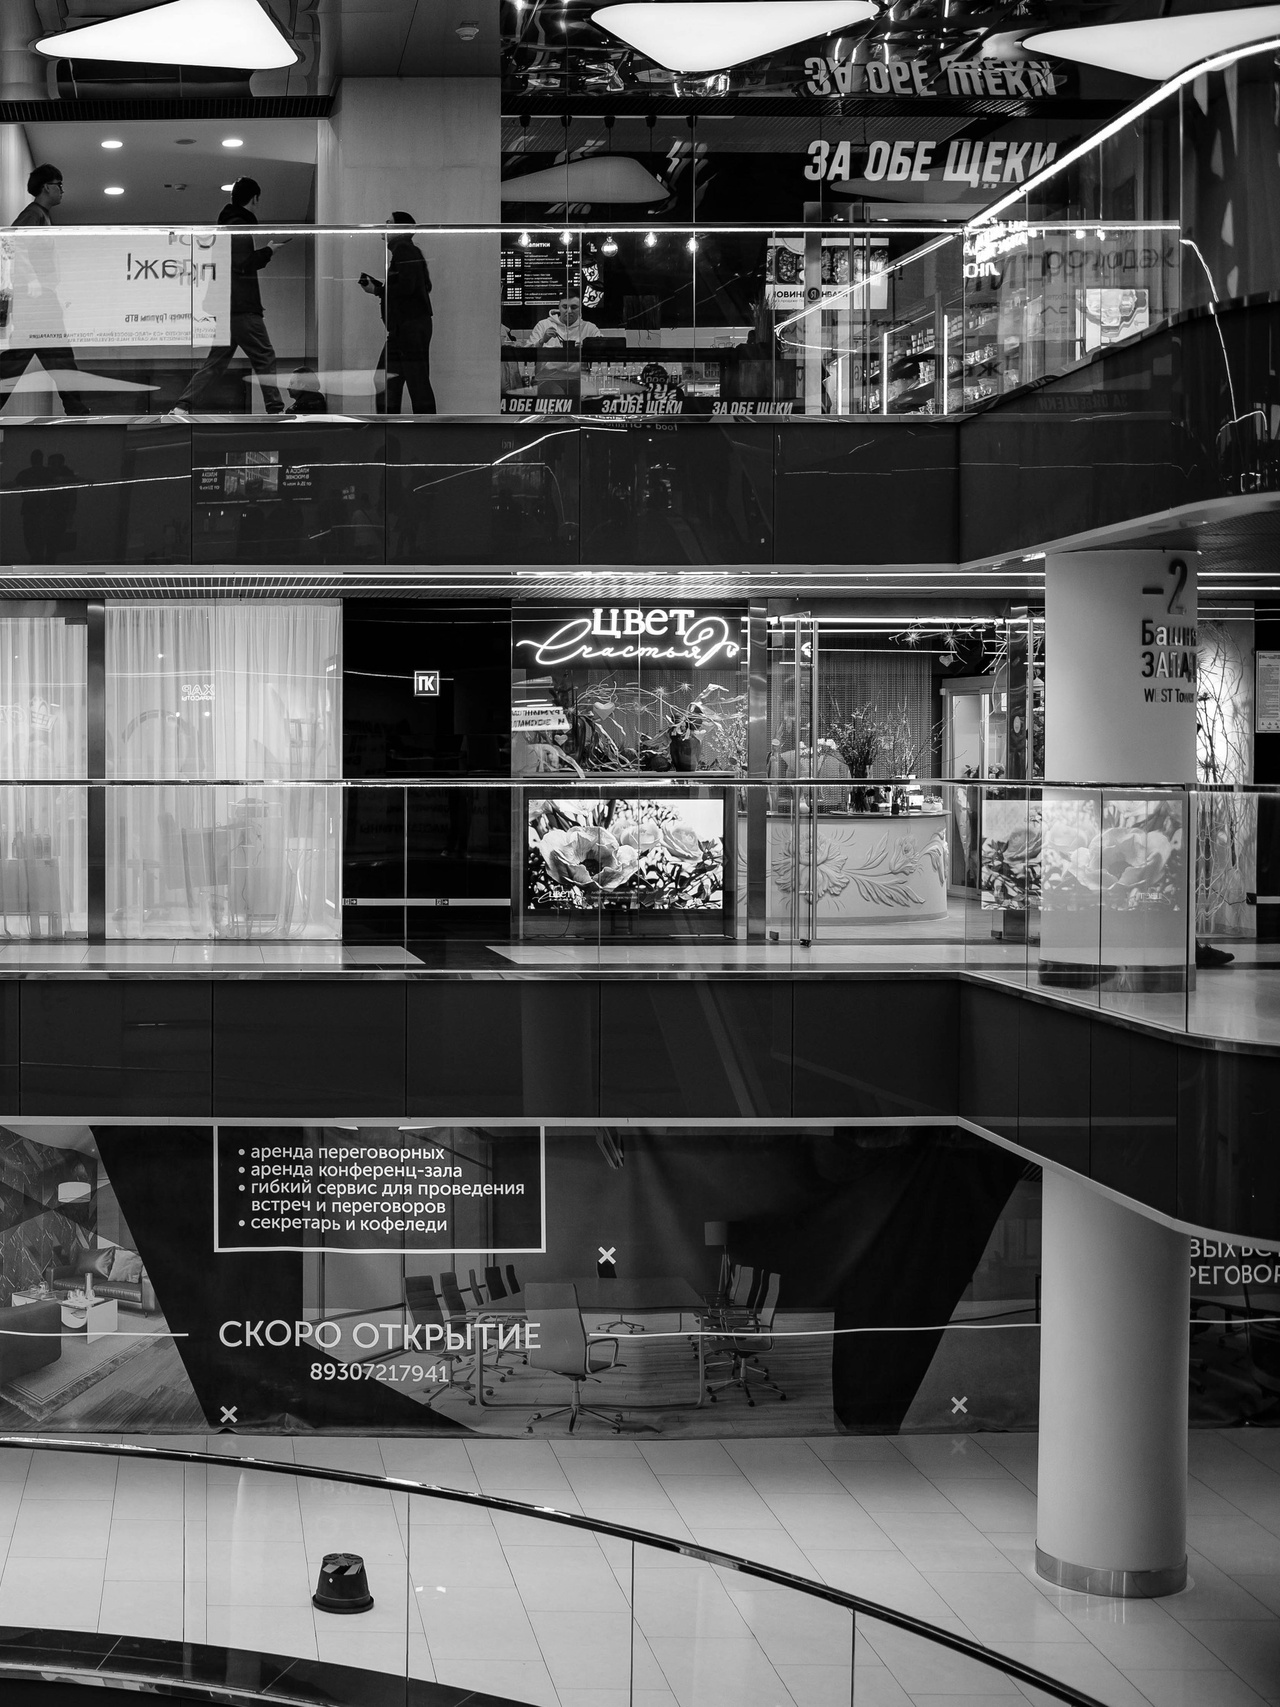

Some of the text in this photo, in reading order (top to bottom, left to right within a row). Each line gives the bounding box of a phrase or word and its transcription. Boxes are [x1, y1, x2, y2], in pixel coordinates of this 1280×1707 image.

[804, 140, 1058, 188] ЗА ОБЕ ЩЕКИ
[509, 399, 533, 413] ОБЕ
[535, 399, 573, 415] ЩЕКИ
[601, 400, 683, 415] ЗА ОБЕ ЩЕКИ
[712, 401, 728, 415] ЗА
[730, 402, 754, 415] ОБЕ
[1141, 619, 1197, 647] Башня
[1141, 651, 1197, 683] ЗАПАД
[1144, 688, 1173, 703] WEST
[251, 1147, 445, 1162] аренда переговорных
[251, 1163, 463, 1180] аренда конференц-зала
[251, 1179, 525, 1198] гибкий сервис для проведения
[251, 1199, 446, 1215] встреч и переговоров
[251, 1217, 447, 1234] секретарь и кофеледи
[219, 1320, 541, 1350] СКОРО ОТКРЫТИЕ
[310, 1362, 449, 1383] 89307217941
